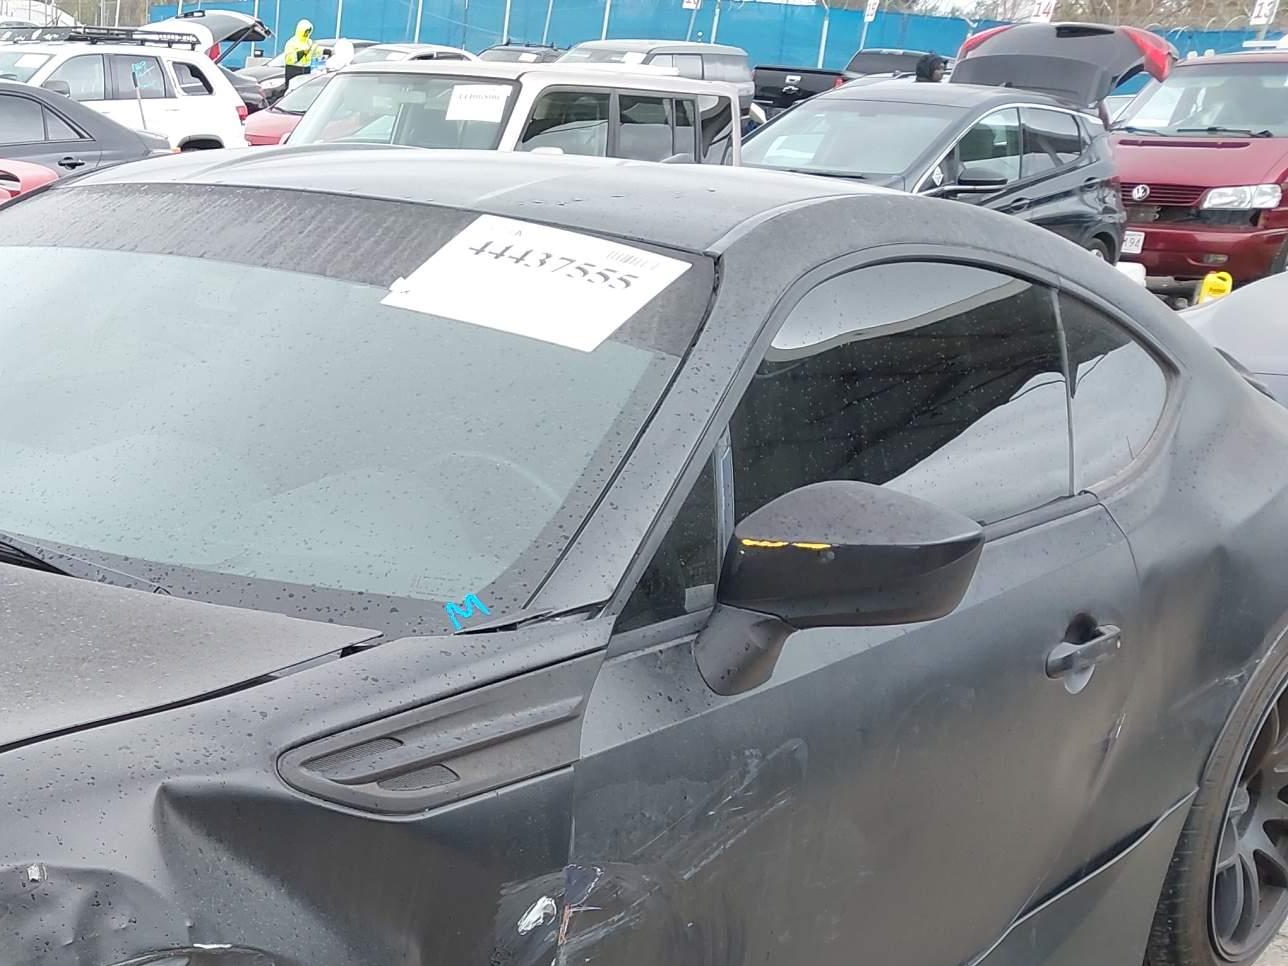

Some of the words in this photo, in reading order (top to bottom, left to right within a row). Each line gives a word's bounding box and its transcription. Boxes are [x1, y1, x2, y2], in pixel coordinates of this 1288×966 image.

[1032, 1, 1052, 17] 14
[1254, 1, 1275, 18] 13
[469, 240, 639, 289] 44437555
[445, 592, 492, 631] M
